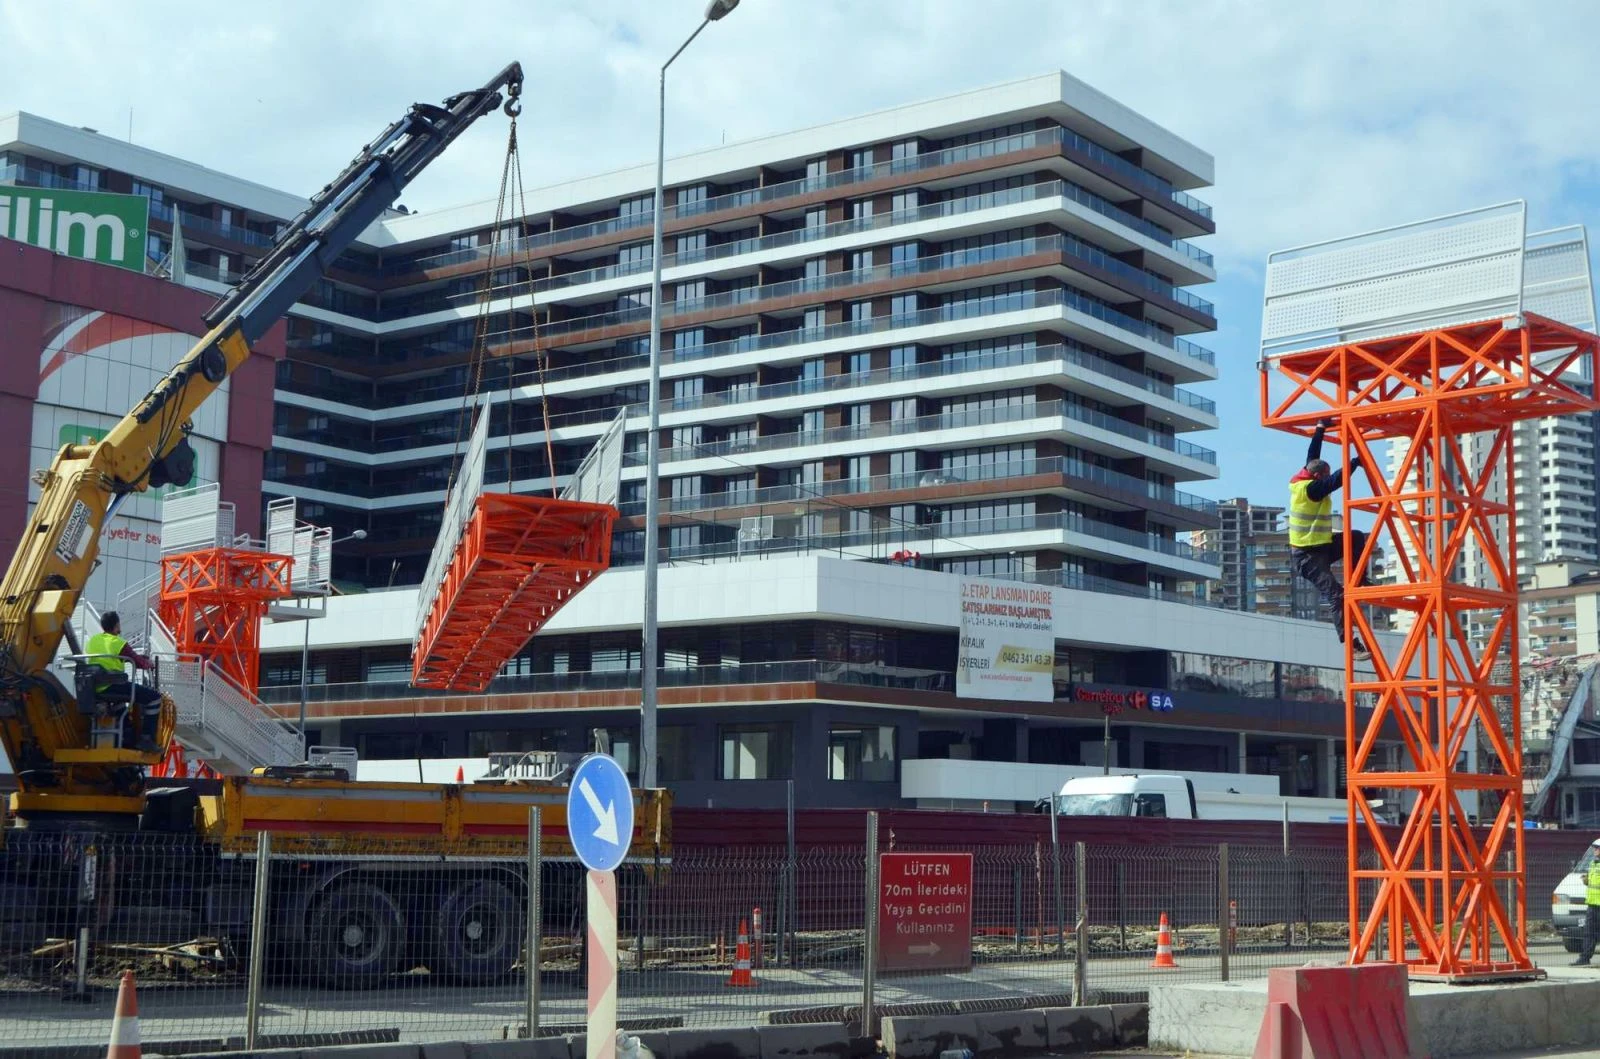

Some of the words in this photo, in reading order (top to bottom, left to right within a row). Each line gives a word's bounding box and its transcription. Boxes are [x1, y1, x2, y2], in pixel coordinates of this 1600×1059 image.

[108, 526, 142, 541] yeter
[970, 584, 990, 599] ETAP
[991, 586, 1029, 602] LANSMAN
[961, 635, 985, 648] KİRALIK
[1002, 652, 1019, 664] 0462
[1020, 653, 1033, 665] 341
[1151, 695, 1174, 708] SA
[904, 861, 950, 876] LÜTFEN
[885, 884, 912, 896] 70m
[917, 881, 967, 896] İlerideki
[885, 903, 913, 918] Yaya
[896, 921, 955, 934] Kullanınız
